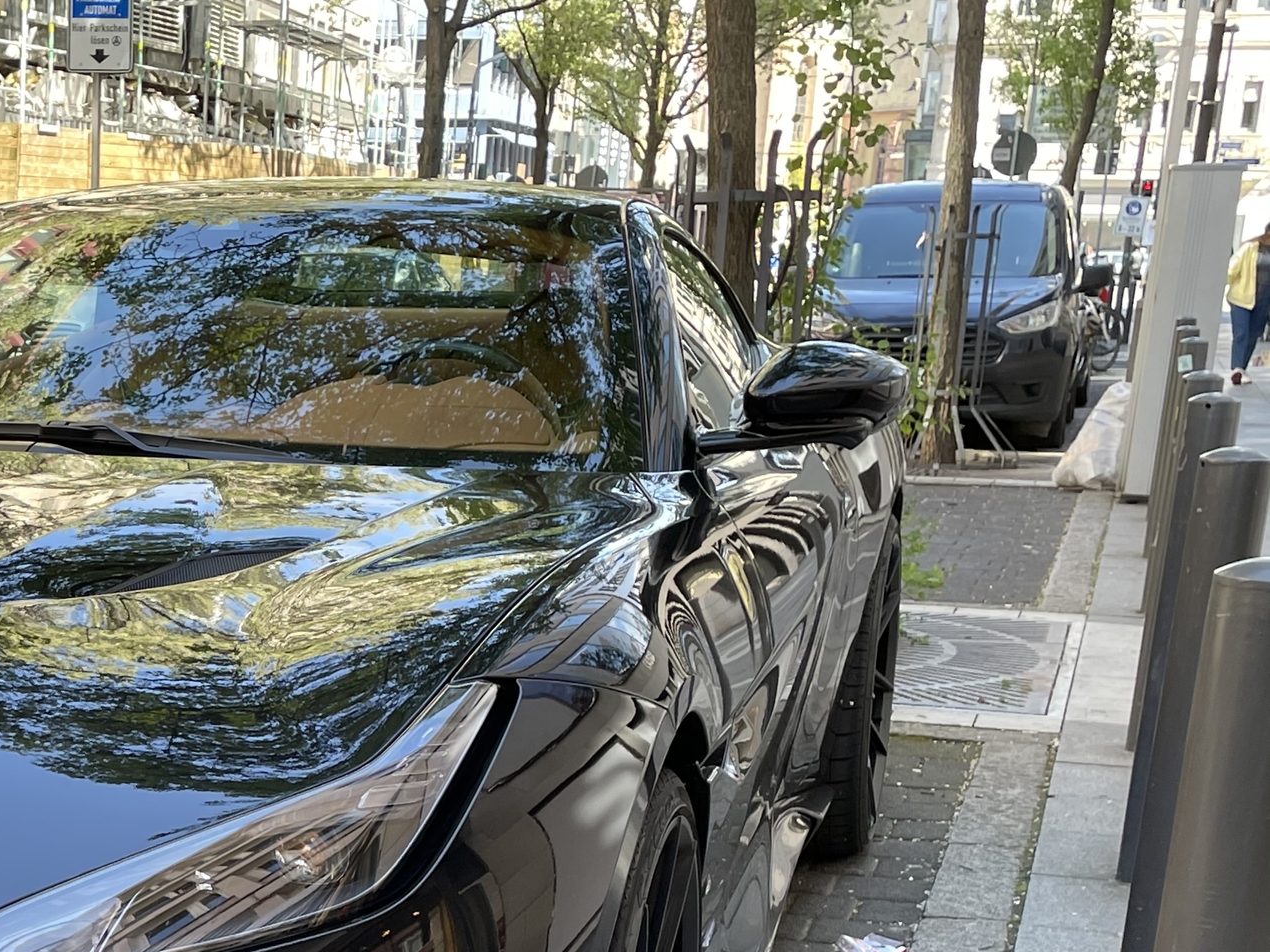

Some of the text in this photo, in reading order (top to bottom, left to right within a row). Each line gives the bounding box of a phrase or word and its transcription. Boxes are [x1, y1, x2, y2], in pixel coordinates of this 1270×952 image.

[84, 5, 117, 15] AUTOMAT
[72, 22, 128, 33] Hier Parkschein
[91, 36, 109, 45] lösen
